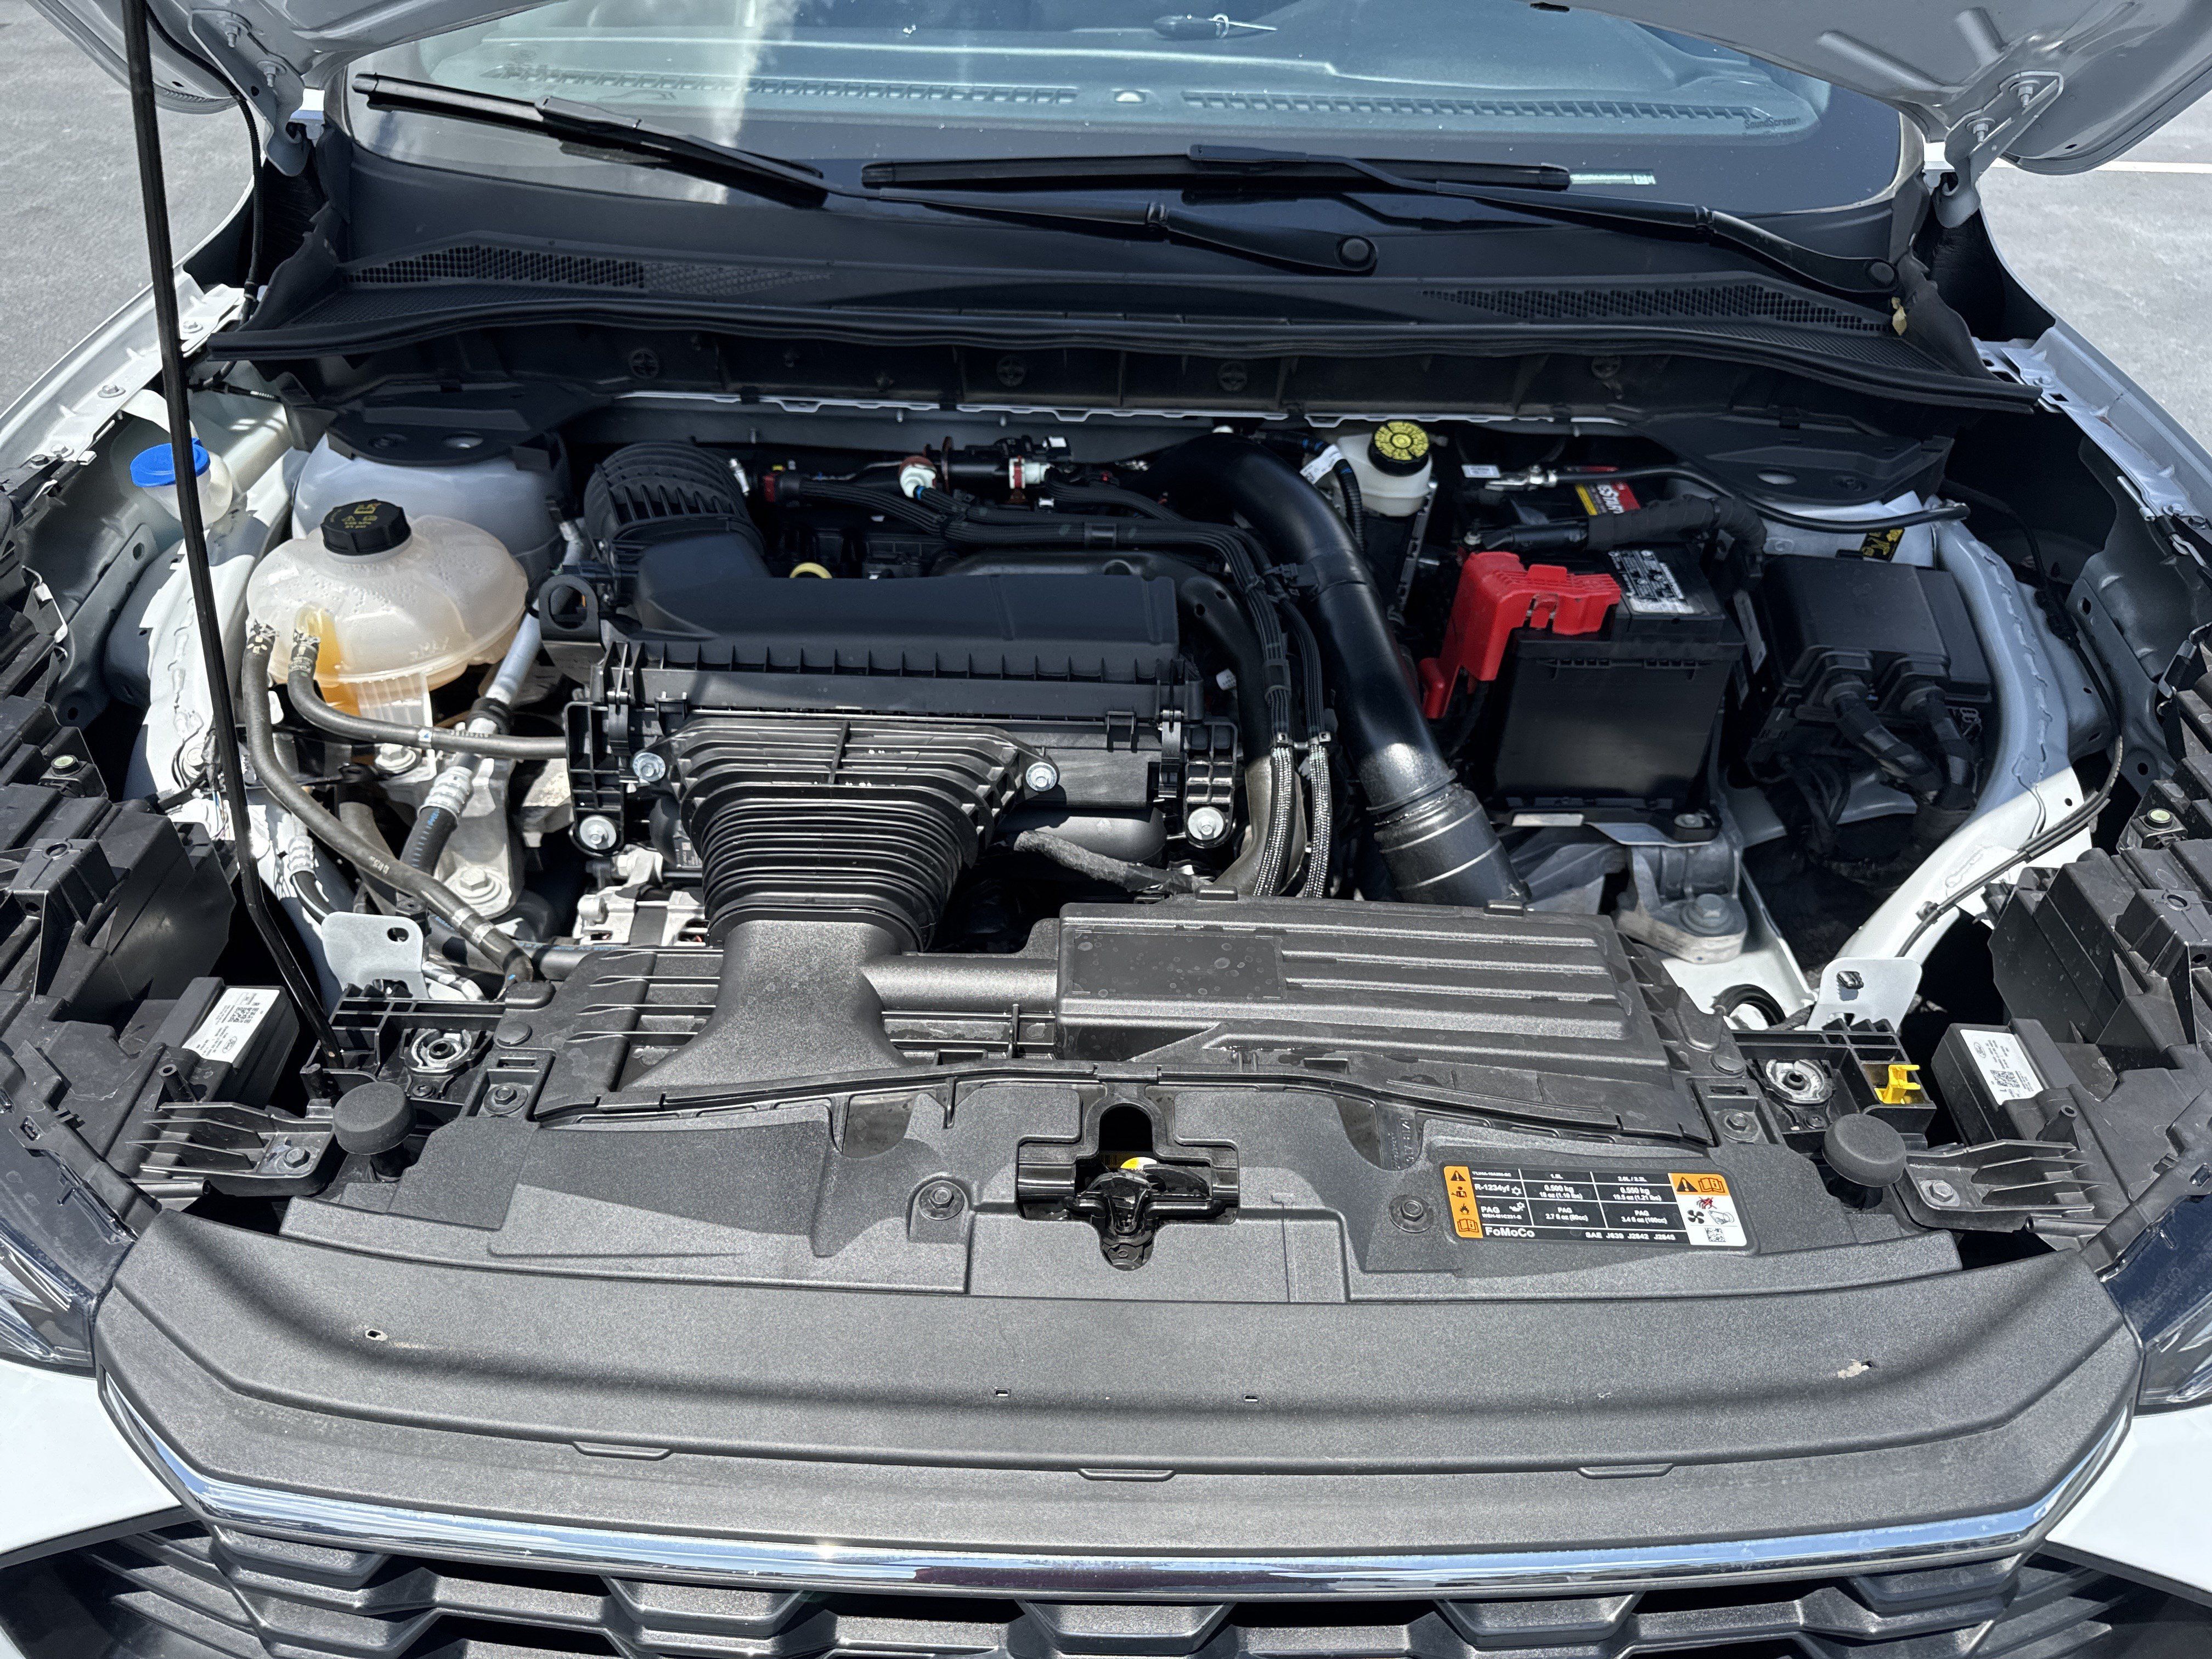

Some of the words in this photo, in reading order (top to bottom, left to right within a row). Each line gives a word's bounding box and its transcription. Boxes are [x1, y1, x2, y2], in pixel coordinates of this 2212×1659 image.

[1474, 1183, 1510, 1193] R-1234yf
[1639, 1187, 1650, 1195] kg
[1485, 1227, 1536, 1238] FoMoCo
